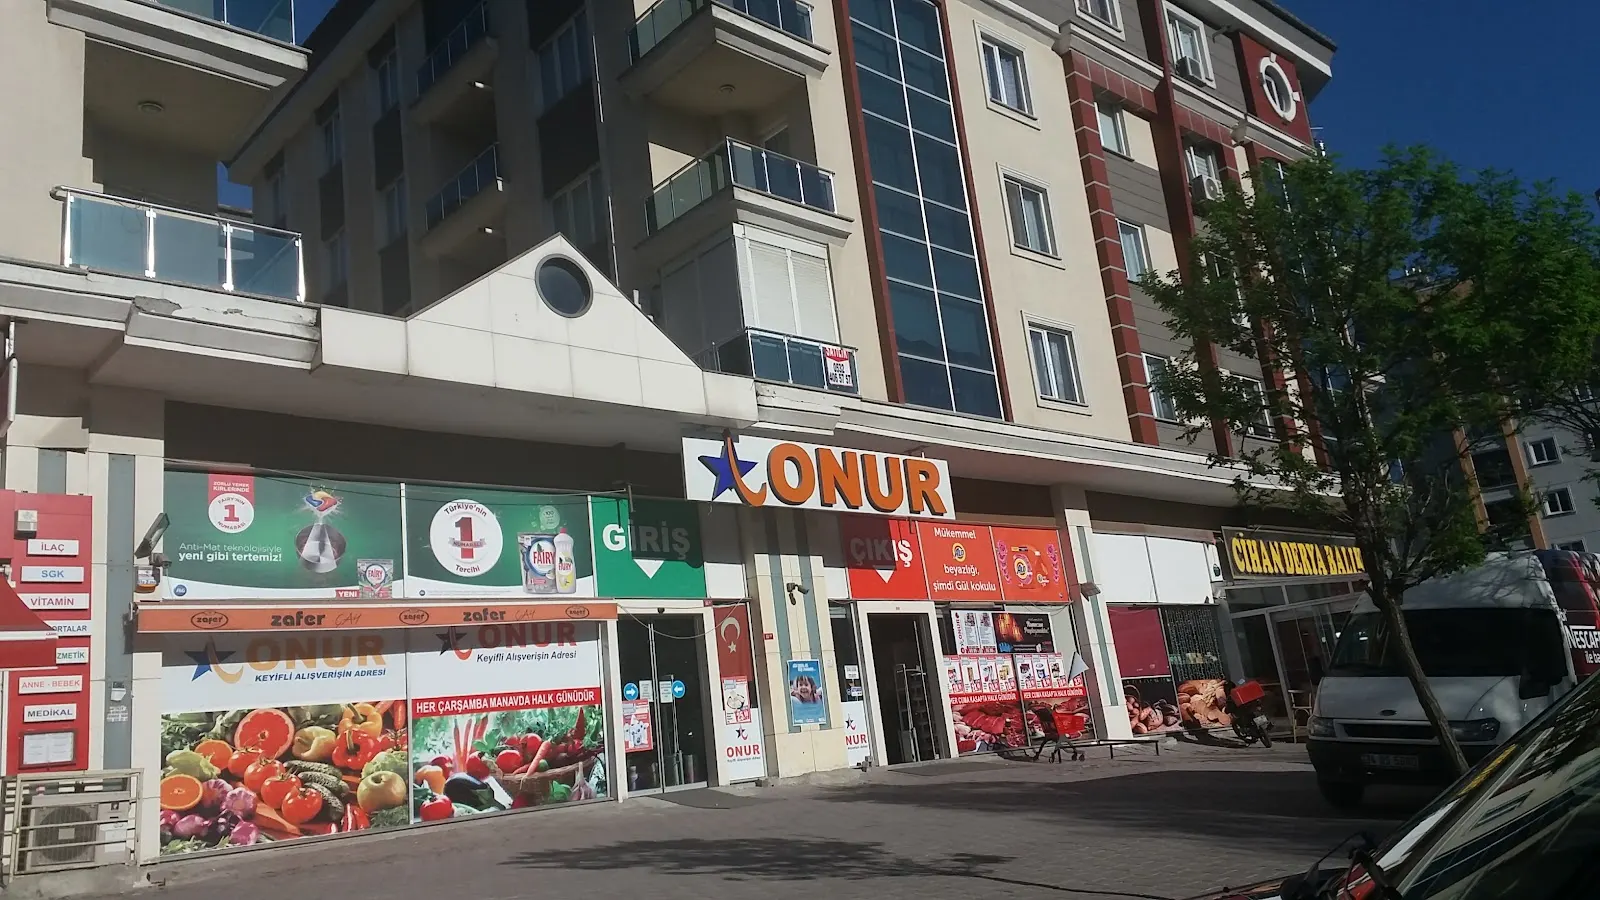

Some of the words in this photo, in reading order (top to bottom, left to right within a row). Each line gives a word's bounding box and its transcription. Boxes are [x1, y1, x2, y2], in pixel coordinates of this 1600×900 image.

[767, 443, 947, 516] ONUR
[224, 504, 240, 522] 1
[455, 516, 475, 559] 1
[602, 520, 691, 560] GİRİŞ
[934, 527, 977, 540] Mükemmel
[41, 541, 65, 553] İLAÇ
[179, 542, 221, 551] Anti-Mat
[223, 544, 282, 554] teknolojisiyle
[851, 536, 913, 568] ÇIKIŞ
[178, 551, 203, 561] yeni
[206, 551, 229, 563] gibi
[231, 552, 282, 562] tertemiz!
[533, 551, 556, 565] FAIRY
[1284, 541, 1327, 576] DERYA
[41, 569, 65, 578] SGK
[455, 564, 481, 574] Tercihi
[933, 580, 954, 593] şimdi
[955, 580, 970, 592] Gül
[971, 581, 997, 592] kokulu
[30, 597, 74, 606] VİTAMİN
[196, 616, 223, 625] zafer
[271, 611, 326, 627] zafer
[404, 614, 425, 622] zafer
[463, 608, 507, 622] zafer
[477, 622, 577, 649] ONUR
[1566, 625, 1600, 649] NESCAF
[245, 633, 387, 671] ONUR
[476, 652, 504, 663] Keyifli
[505, 651, 549, 663] Alışverişin
[551, 649, 577, 660] Adresi
[255, 672, 292, 682] KEYİFLİ
[294, 669, 352, 682] ALIŞVERİŞİN
[354, 667, 387, 678] ADRESİ
[21, 680, 45, 689] ANNE
[52, 679, 81, 688] BEBEK
[416, 702, 436, 714] HER
[437, 698, 489, 713] ÇARŞAMBA
[489, 695, 531, 709] MANAVDA
[531, 693, 554, 706] HALK
[556, 691, 595, 704] GÜNÜDÜR
[27, 708, 73, 718] MEDİKAL
[726, 744, 760, 758] ONUR
